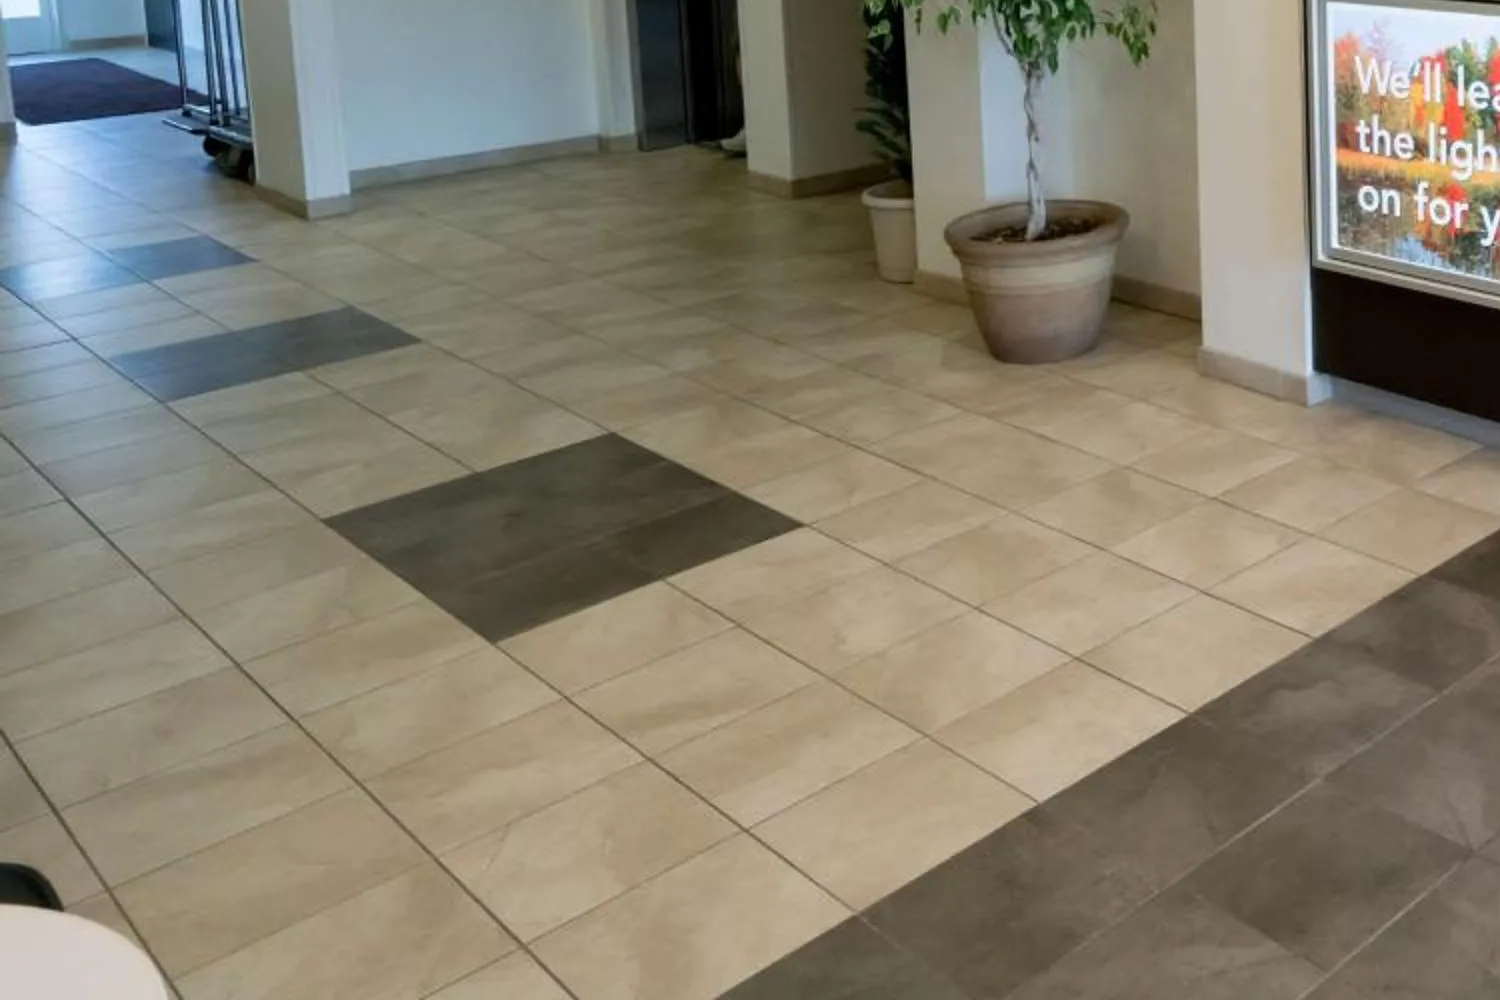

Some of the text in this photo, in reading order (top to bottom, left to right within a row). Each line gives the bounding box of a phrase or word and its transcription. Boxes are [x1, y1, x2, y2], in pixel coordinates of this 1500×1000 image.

[1354, 55, 1441, 104] We'll
[1356, 113, 1415, 160] the
[1357, 184, 1401, 217] on
[1414, 181, 1469, 229] for
